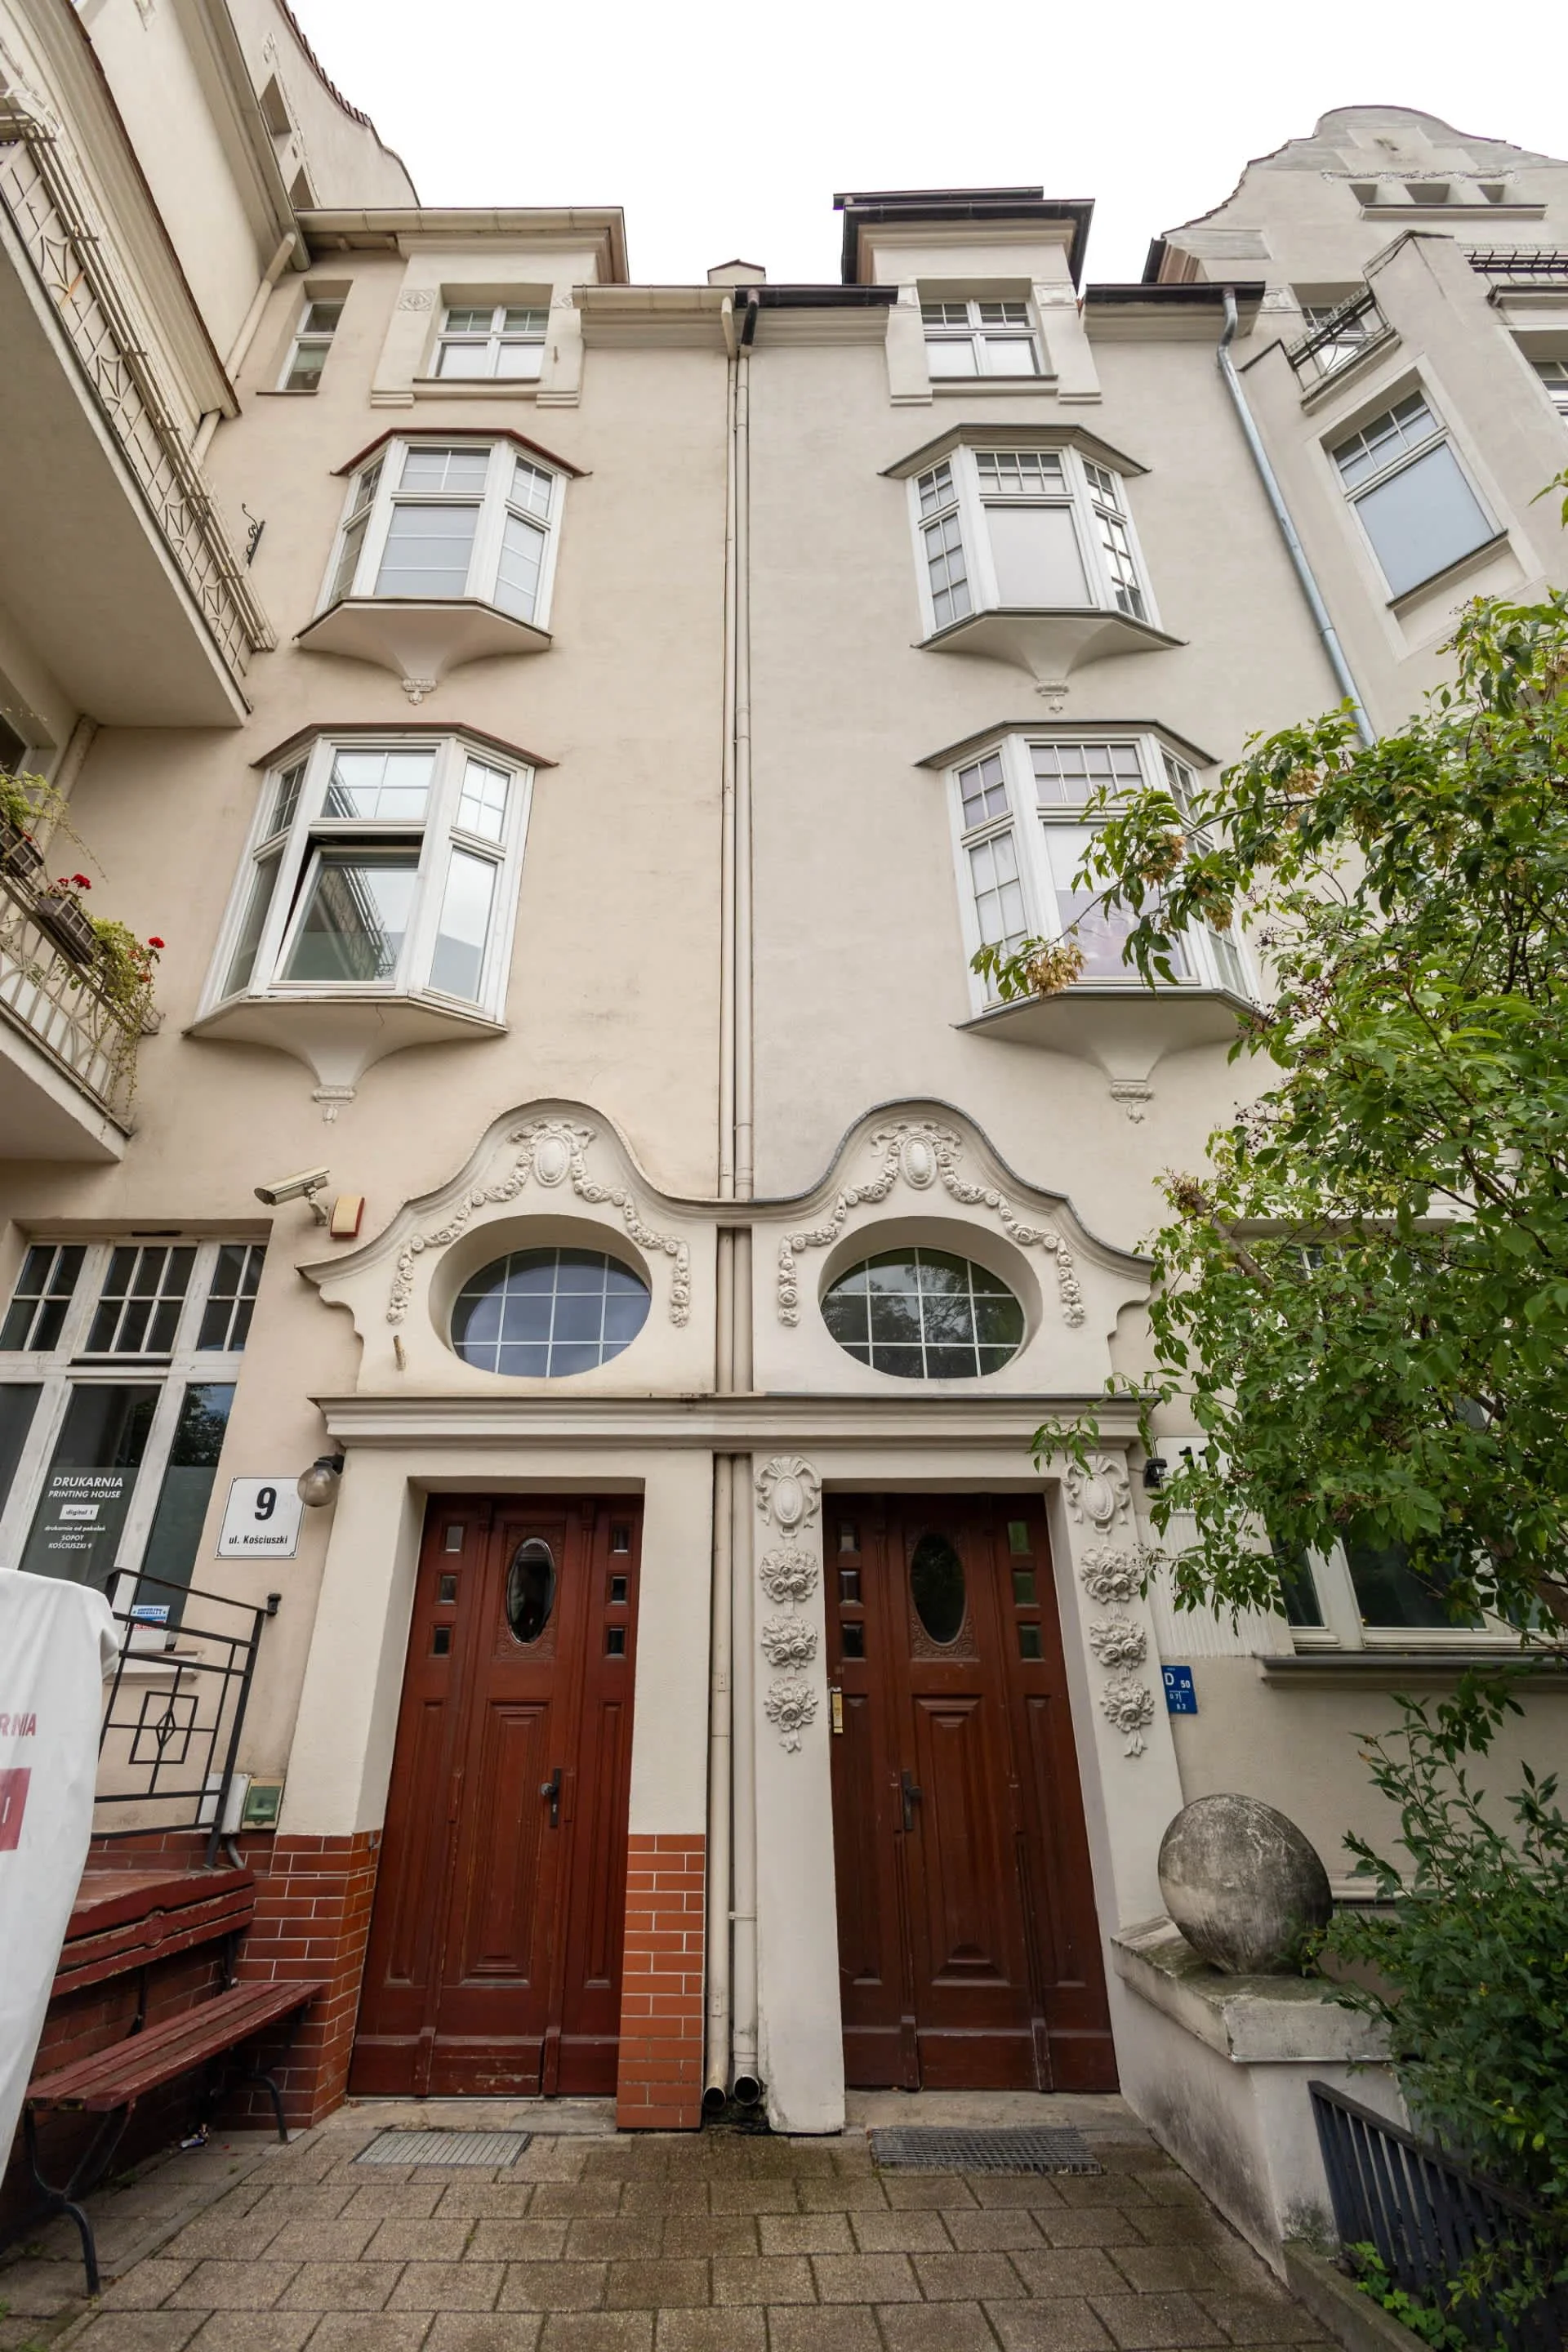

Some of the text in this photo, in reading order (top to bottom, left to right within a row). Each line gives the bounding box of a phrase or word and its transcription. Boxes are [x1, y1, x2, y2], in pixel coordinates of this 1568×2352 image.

[53, 1477, 123, 1487] DRUKARNIA
[255, 1487, 277, 1521] 9
[229, 1535, 288, 1544] ul. Kościuszki
[1164, 1672, 1174, 1686] D
[1180, 1679, 1191, 1689] 50
